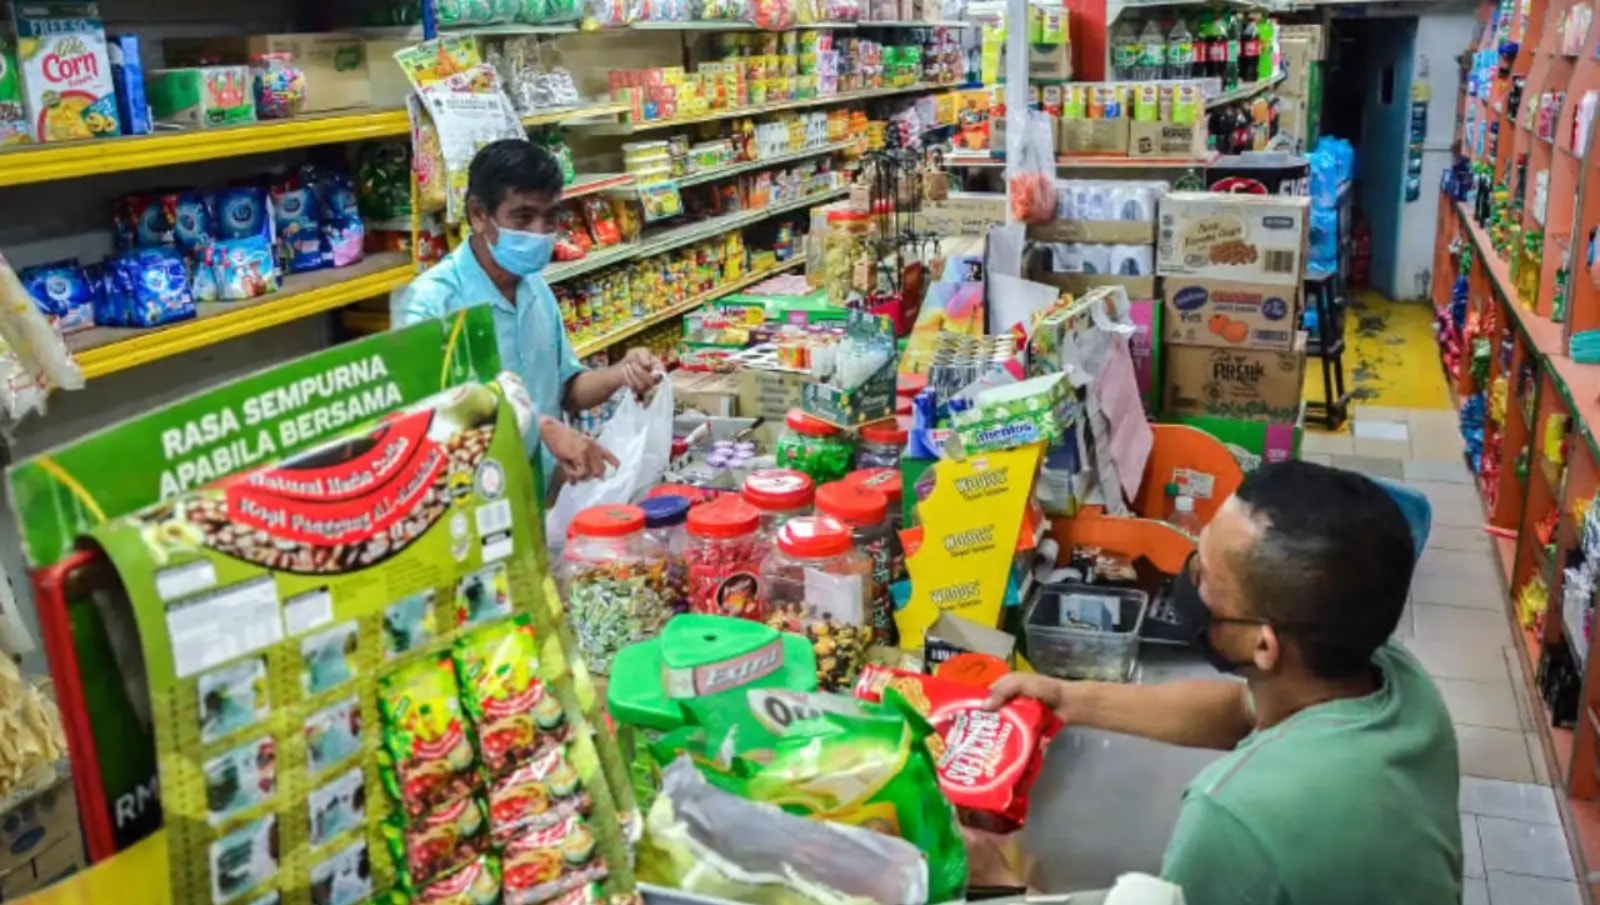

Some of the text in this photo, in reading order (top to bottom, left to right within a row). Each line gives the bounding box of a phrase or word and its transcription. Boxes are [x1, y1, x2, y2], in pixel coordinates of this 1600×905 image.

[42, 52, 98, 83] Corn
[159, 381, 403, 503] APABILA BERSAMA
[162, 354, 388, 460] RASA SEMPURNA
[706, 649, 778, 687] Extra
